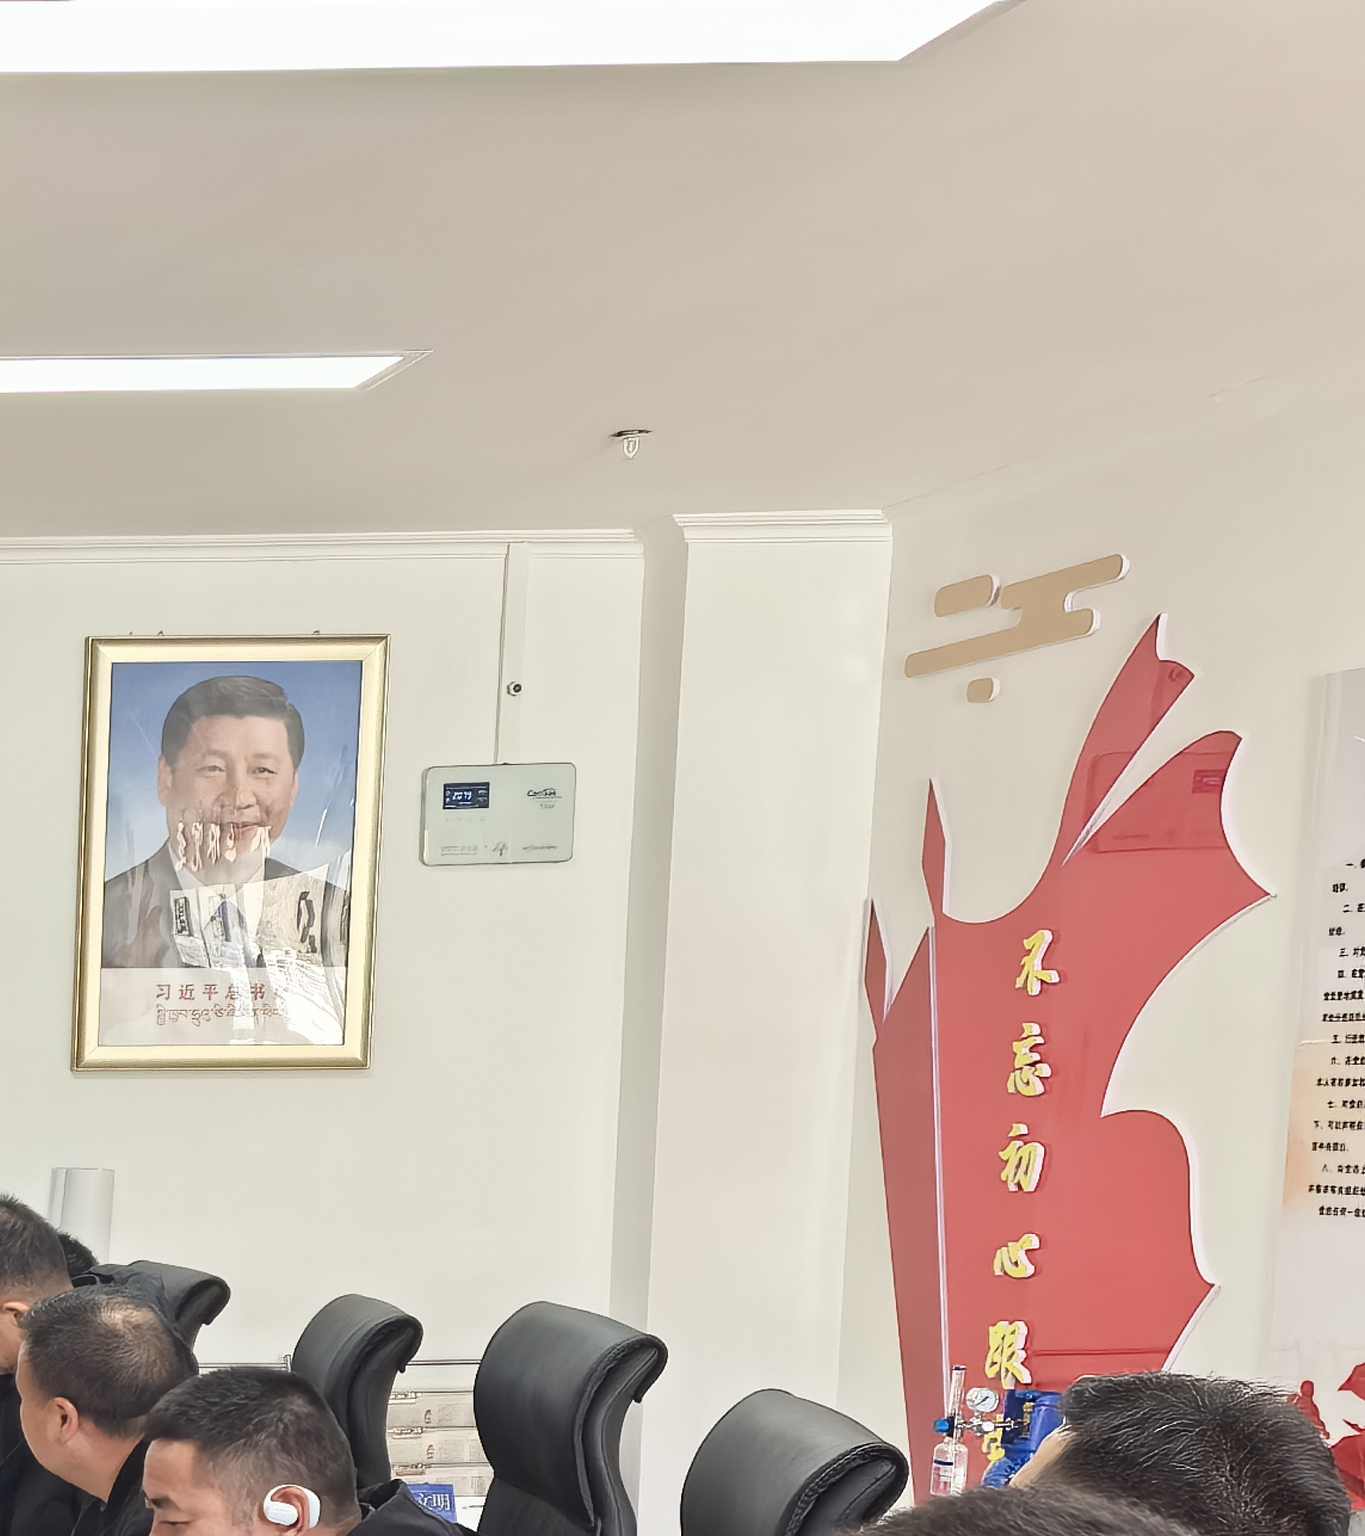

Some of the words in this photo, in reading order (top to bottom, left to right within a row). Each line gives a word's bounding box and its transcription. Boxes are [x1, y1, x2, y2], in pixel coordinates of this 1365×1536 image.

[156, 983, 278, 1001] 习近平总书
[983, 928, 1061, 1463] 不忘初心跟
